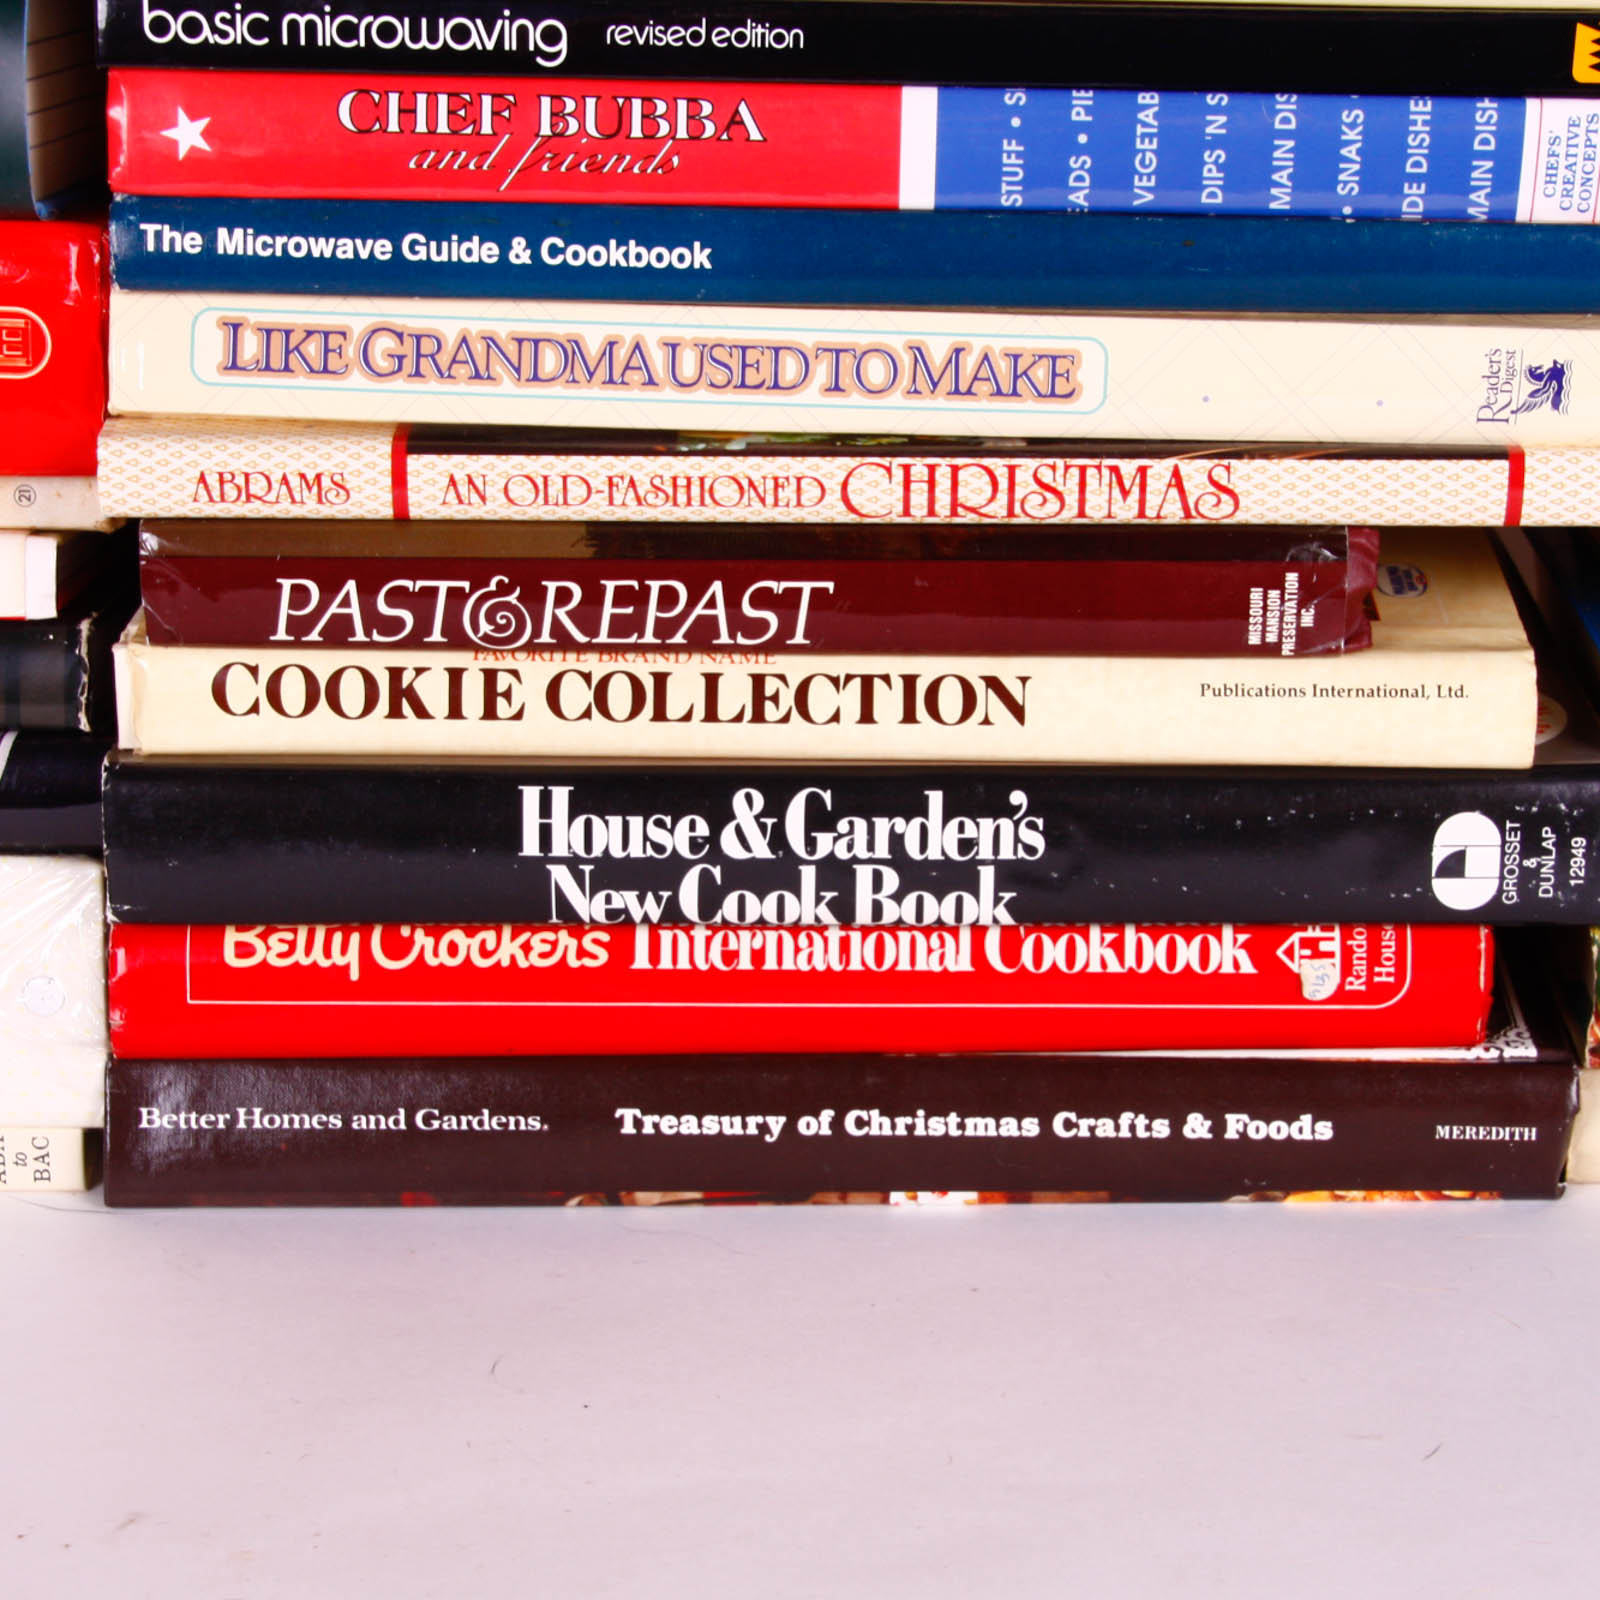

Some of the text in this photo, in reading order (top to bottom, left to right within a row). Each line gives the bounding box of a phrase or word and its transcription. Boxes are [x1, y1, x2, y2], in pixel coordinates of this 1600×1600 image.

[143, 0, 568, 68] basic microwaving
[606, 17, 804, 49] revised edition
[337, 89, 767, 142] CHEF BUBBA
[1205, 115, 1228, 140] 'N
[1405, 97, 1432, 174] DISHE
[408, 121, 681, 193] and friends
[1000, 88, 1026, 207] STUFF S
[1132, 91, 1160, 206] VEGETAB
[1201, 149, 1226, 204] DIPS
[1268, 139, 1296, 210] MAIN
[1336, 108, 1365, 197] SNAKS
[1543, 130, 1562, 198] CHEFS'
[1559, 115, 1581, 211] CREATIVE
[1577, 112, 1600, 213] CONCEPTS
[1066, 155, 1092, 213] ADS
[1467, 160, 1495, 221] MAIN
[140, 223, 713, 270] The Microwave Guide & Cookbook
[221, 321, 1076, 399] LIKE GRANDMA USED TO MAKE
[1476, 348, 1513, 424] Reader's
[1500, 349, 1518, 393] Digest
[192, 471, 351, 506] ABRAMS
[441, 461, 1240, 521] AN OLD-FASHIONED CHRISTMAS
[269, 575, 834, 650] PAST & REPAST
[1248, 587, 1264, 645] MISSOURI
[1265, 589, 1281, 643] MANSION
[1281, 572, 1299, 656] PRESERVATION
[1300, 604, 1315, 628] INC.
[211, 663, 1032, 727] COOKIE COLLECTION
[1199, 682, 1469, 701] Publications International, Ltd.
[518, 785, 1046, 861] House & Garden's
[1502, 819, 1521, 905] GROSSET
[1522, 857, 1541, 868] &
[1538, 826, 1556, 898] DUNLAP
[1569, 837, 1587, 886] 12949
[545, 863, 1017, 926] New Cook Book
[629, 924, 976, 973] International
[984, 923, 1259, 975] Cookbook
[1345, 923, 1368, 991] Rando
[139, 1107, 549, 1132] Better Homes and Gardens.
[614, 1108, 1335, 1143] Treasury of Christmas Crafts & Foods
[1434, 1124, 1538, 1142] MEREDITH
[12, 1152, 28, 1167] to
[31, 1136, 51, 1183] BAC
